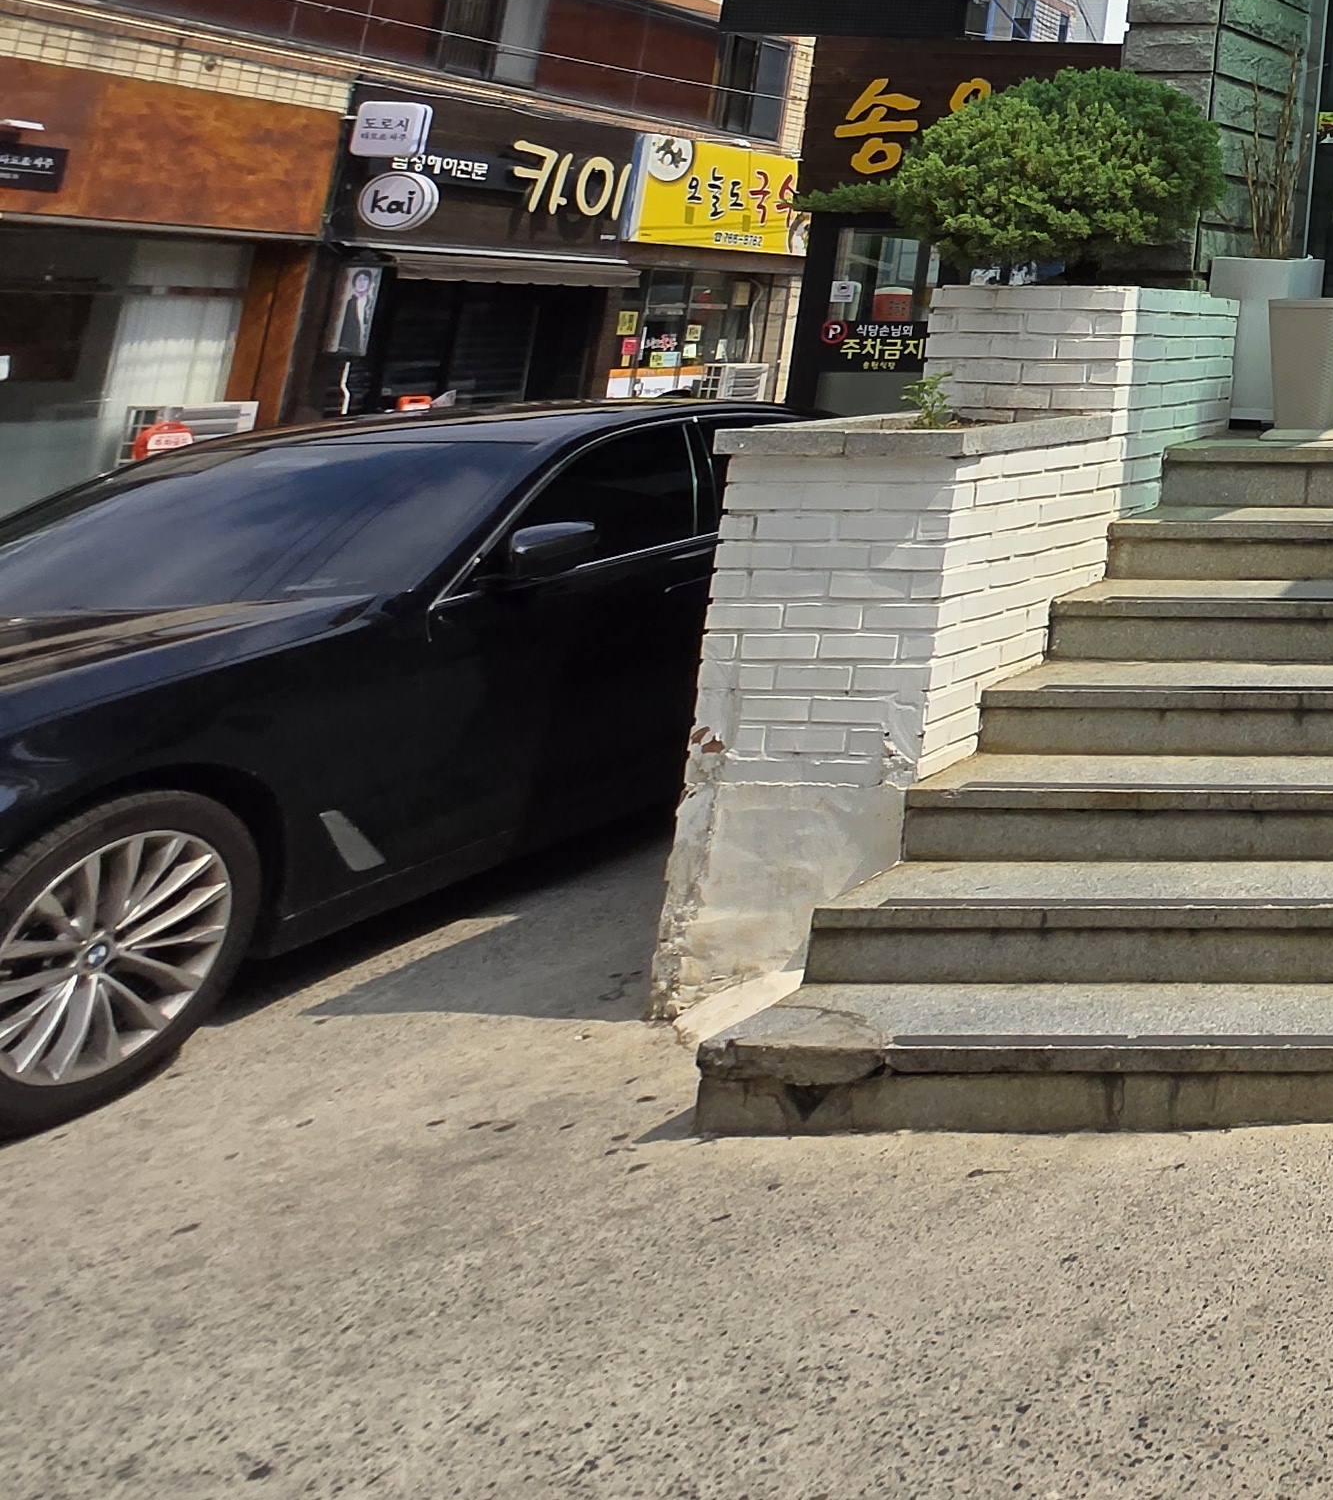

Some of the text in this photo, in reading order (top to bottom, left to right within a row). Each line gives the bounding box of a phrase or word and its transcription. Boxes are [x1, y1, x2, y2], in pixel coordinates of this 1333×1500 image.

[362, 118, 410, 132] 도로시
[834, 78, 992, 174] 송
[513, 139, 633, 221] 카이
[370, 189, 416, 214] kai
[856, 324, 914, 337] 식당손님외
[839, 338, 924, 360] 주차금지
